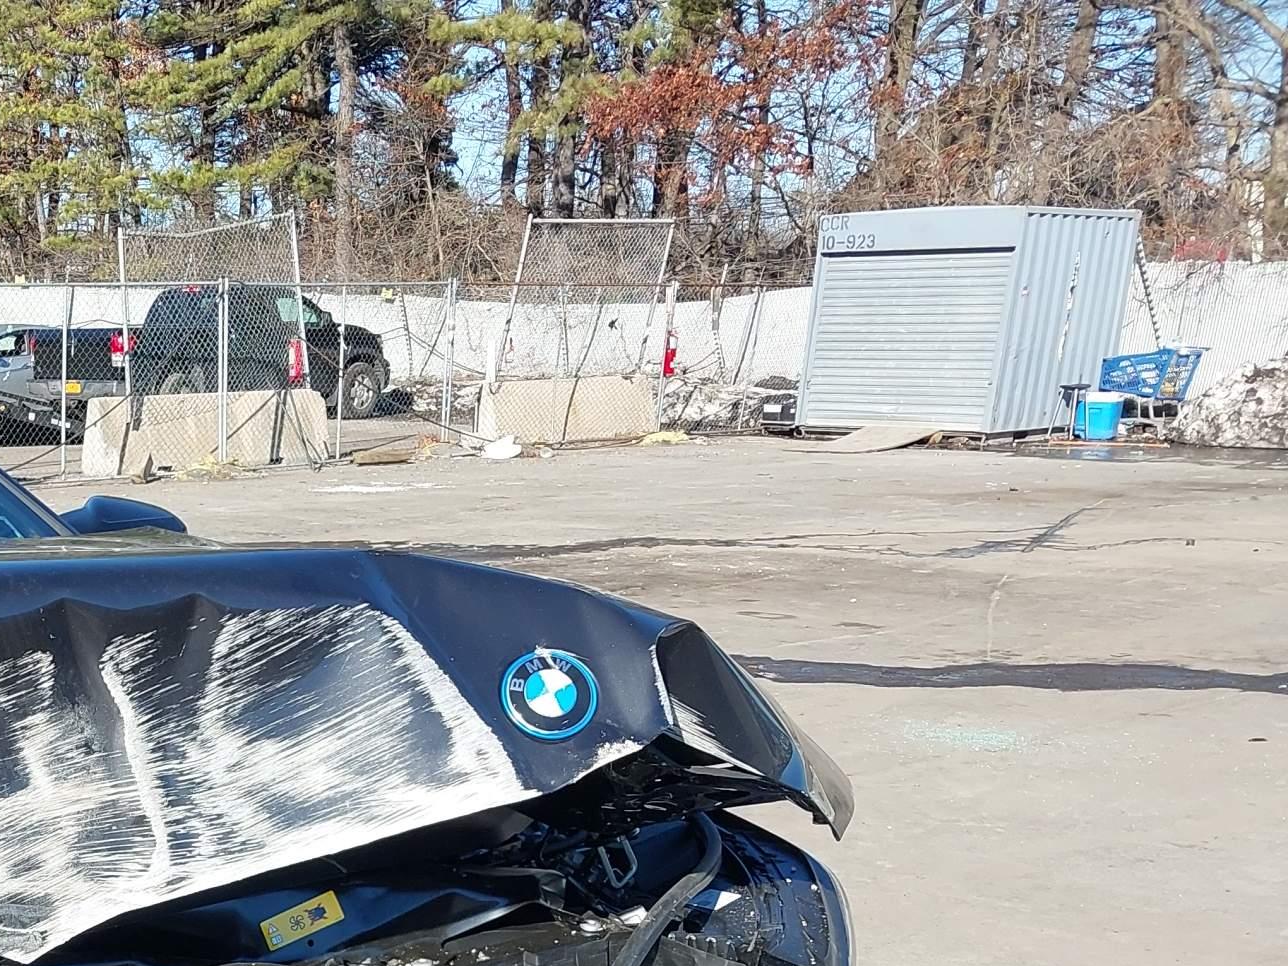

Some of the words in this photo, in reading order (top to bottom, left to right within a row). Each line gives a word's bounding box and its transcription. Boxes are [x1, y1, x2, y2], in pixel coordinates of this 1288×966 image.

[820, 215, 850, 232] CCR
[821, 234, 876, 250] 10-923
[510, 658, 573, 692] BMW
